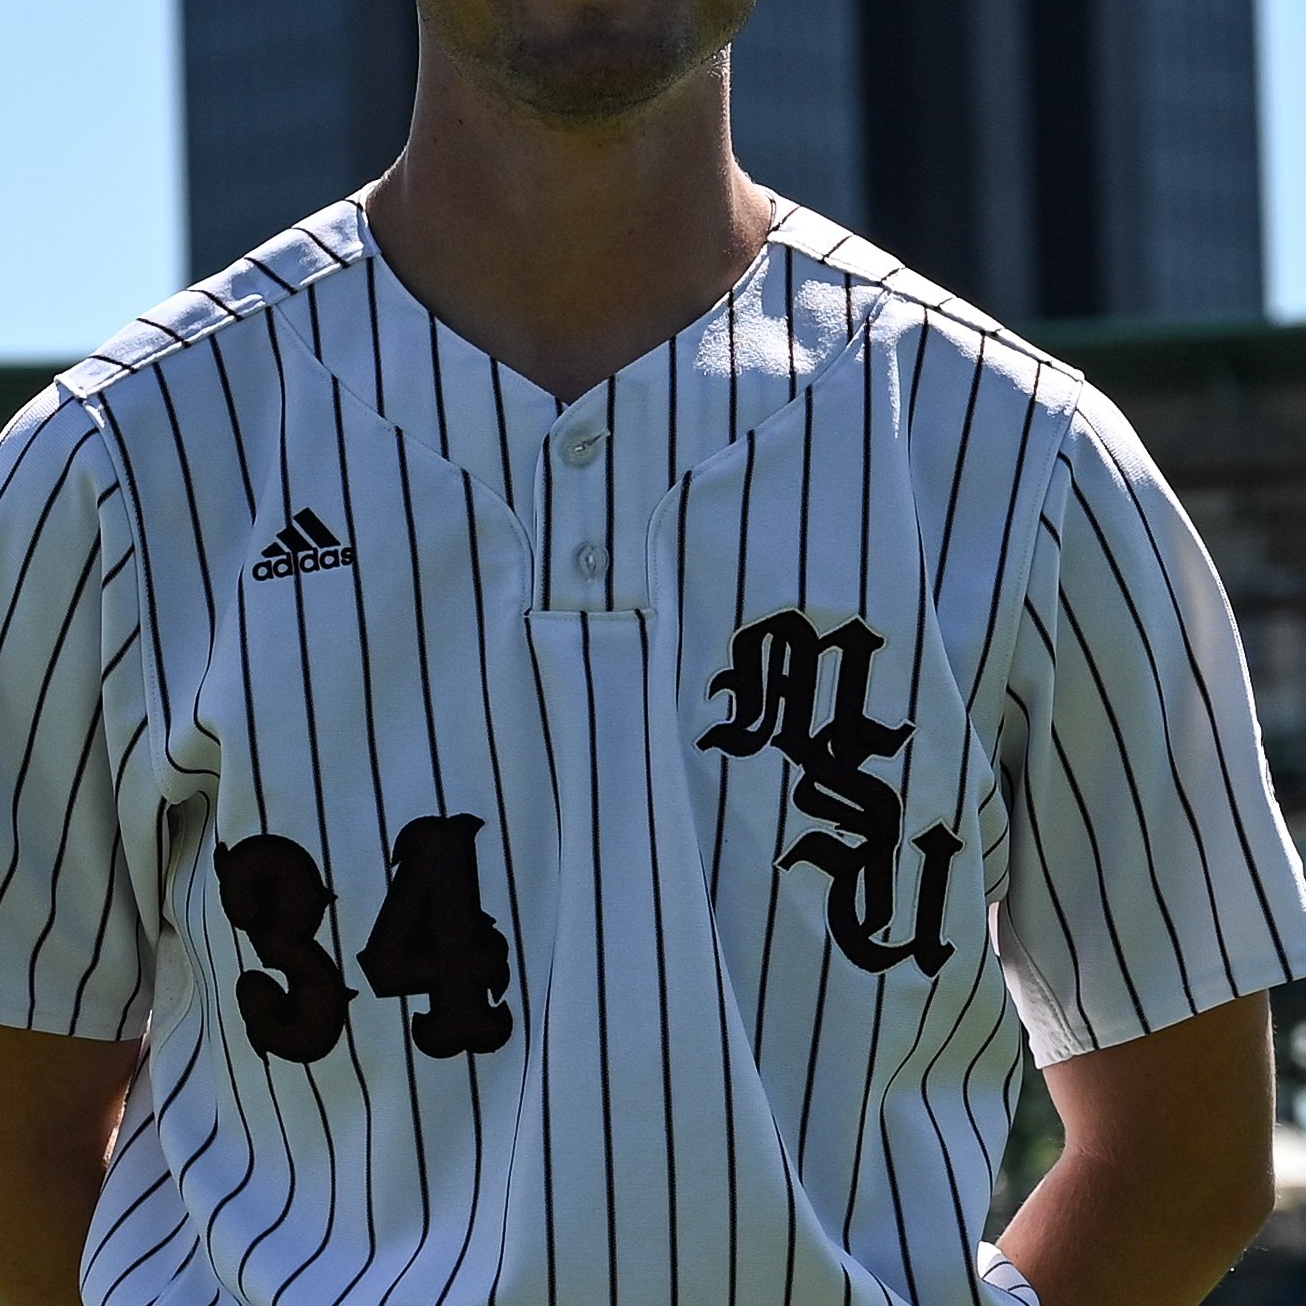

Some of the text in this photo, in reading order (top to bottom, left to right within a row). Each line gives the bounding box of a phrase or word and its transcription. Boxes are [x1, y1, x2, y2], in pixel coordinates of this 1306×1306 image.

[252, 547, 354, 581] adidas
[697, 609, 963, 977] MSU
[214, 813, 513, 1063] 34
